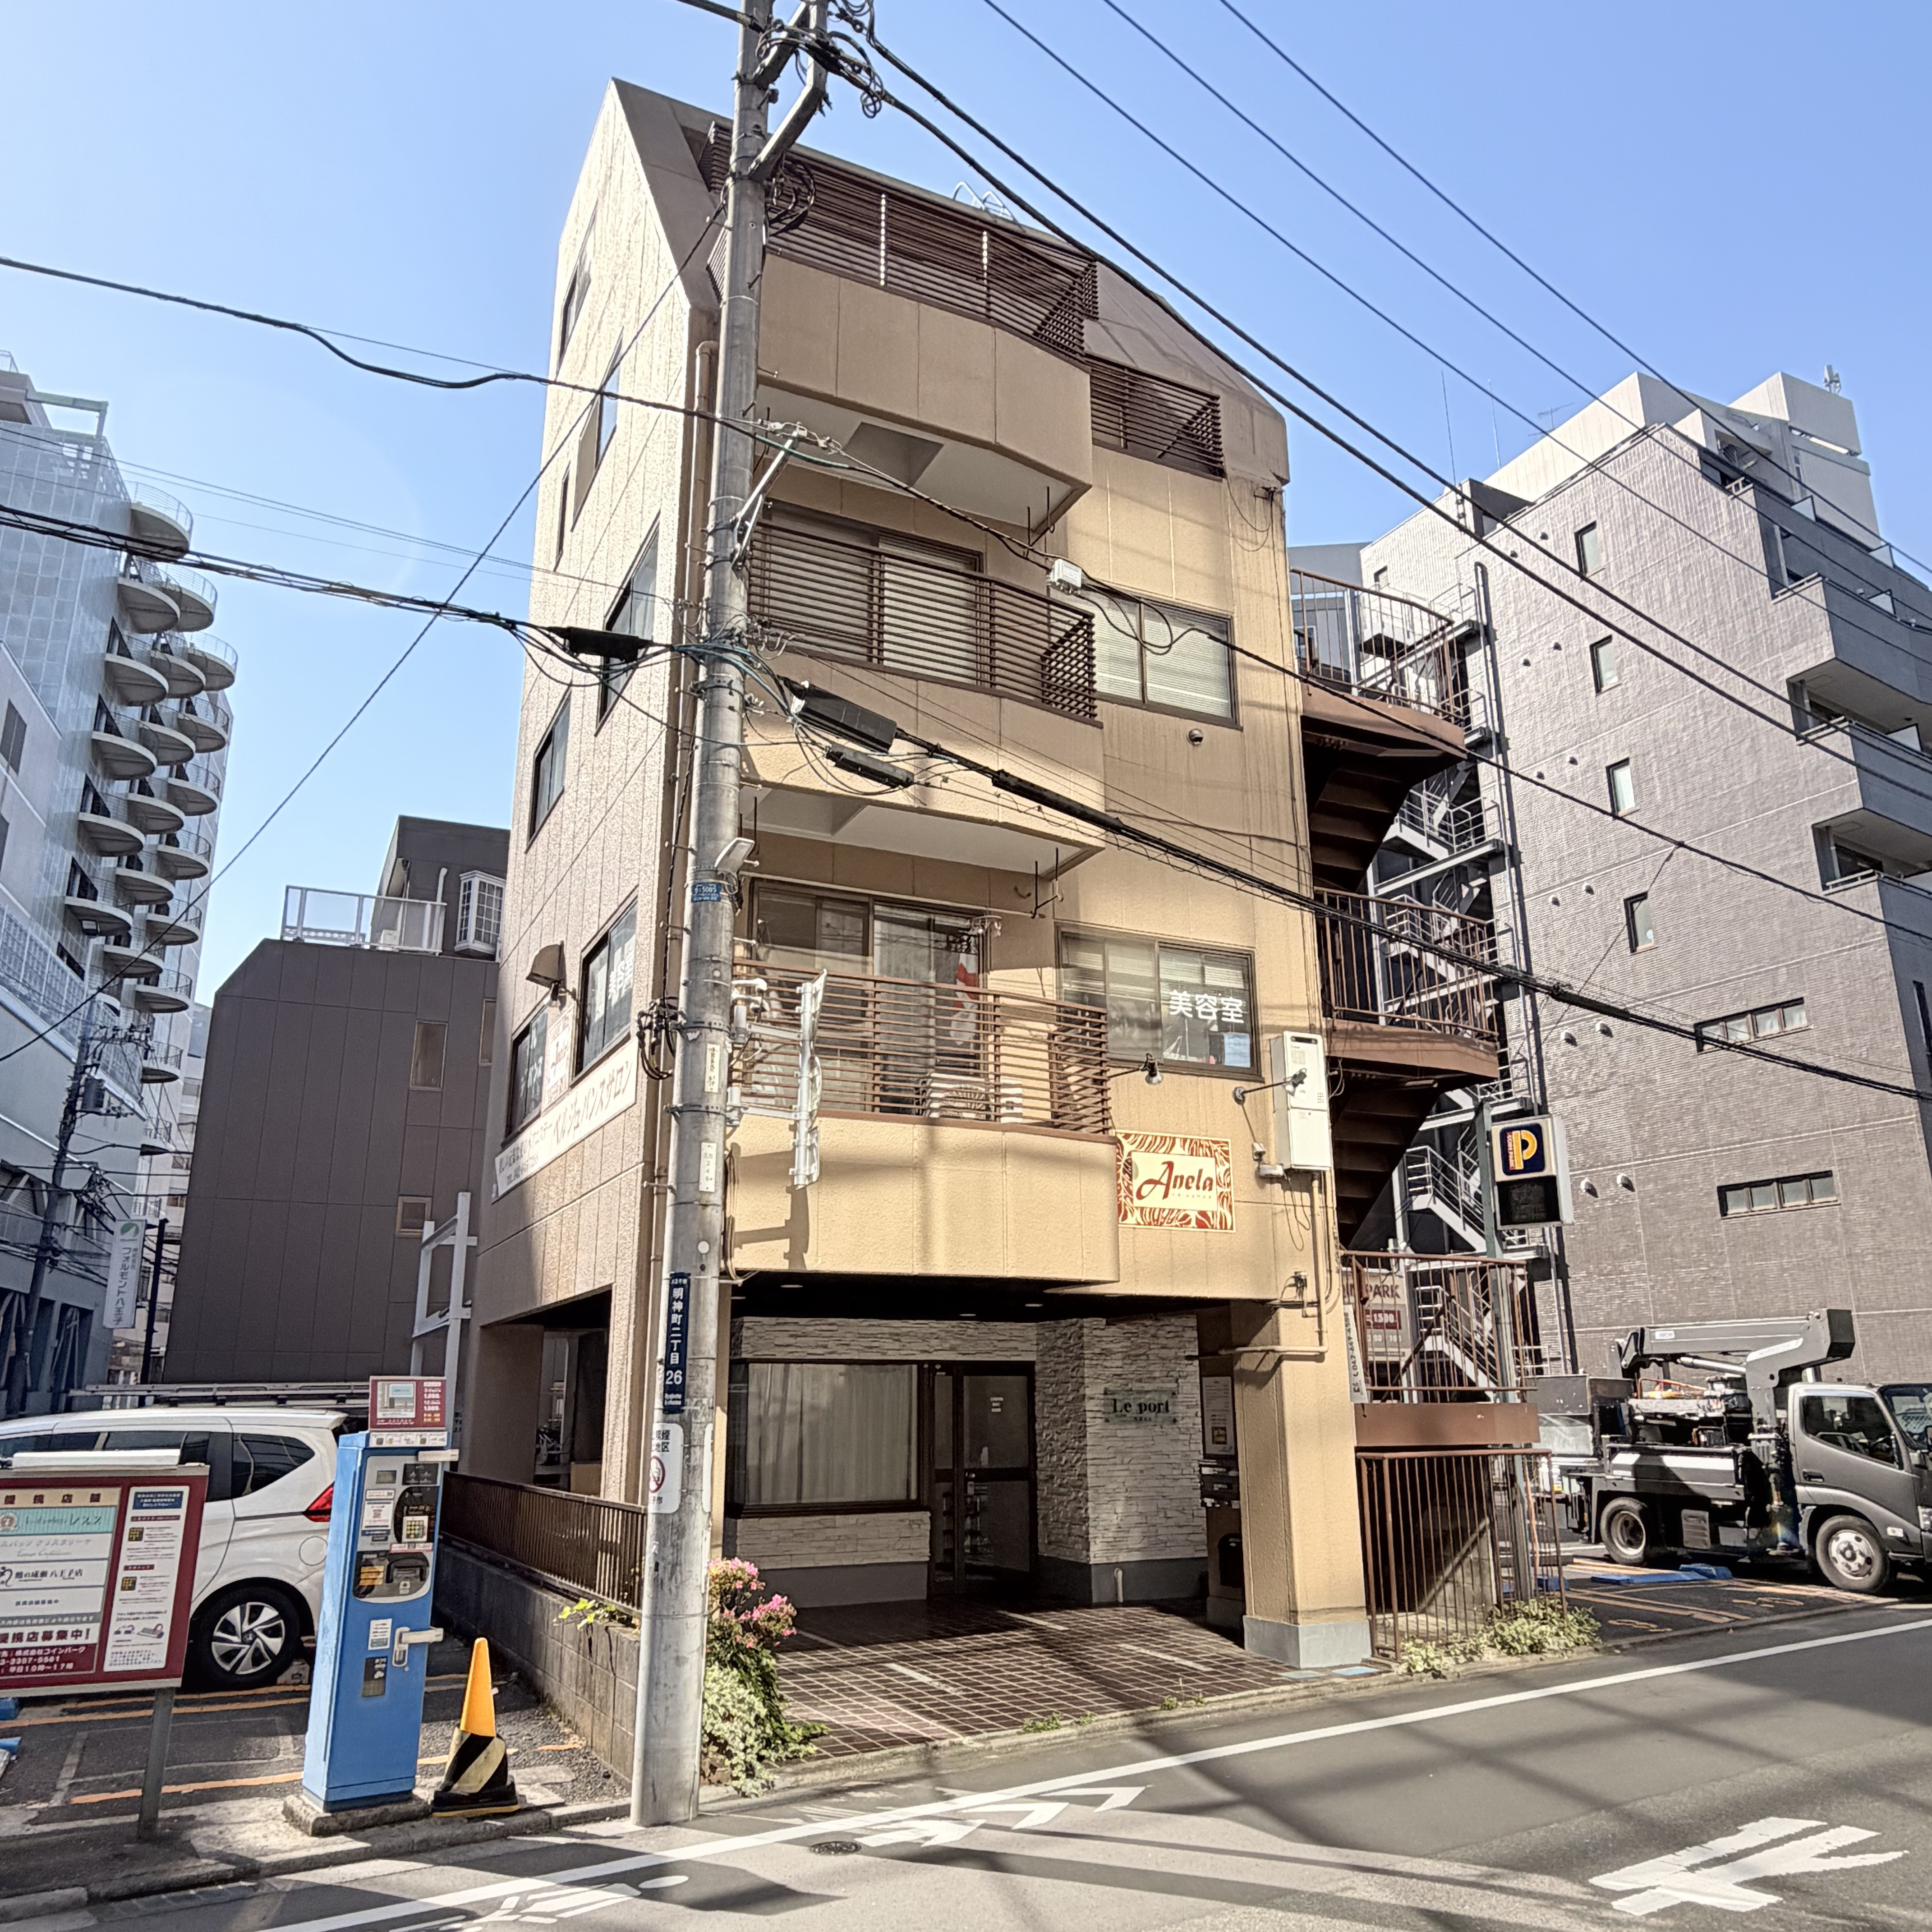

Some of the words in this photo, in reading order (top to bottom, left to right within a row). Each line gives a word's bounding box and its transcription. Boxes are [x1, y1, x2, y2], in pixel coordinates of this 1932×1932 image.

[1169, 989, 1245, 1024] 美容室
[1136, 1160, 1214, 1200] Anela
[670, 1287, 684, 1365] 明神町二丁目
[666, 1370, 682, 1385] 26
[1113, 1398, 1132, 1412] Le
[1136, 1400, 1169, 1414] port
